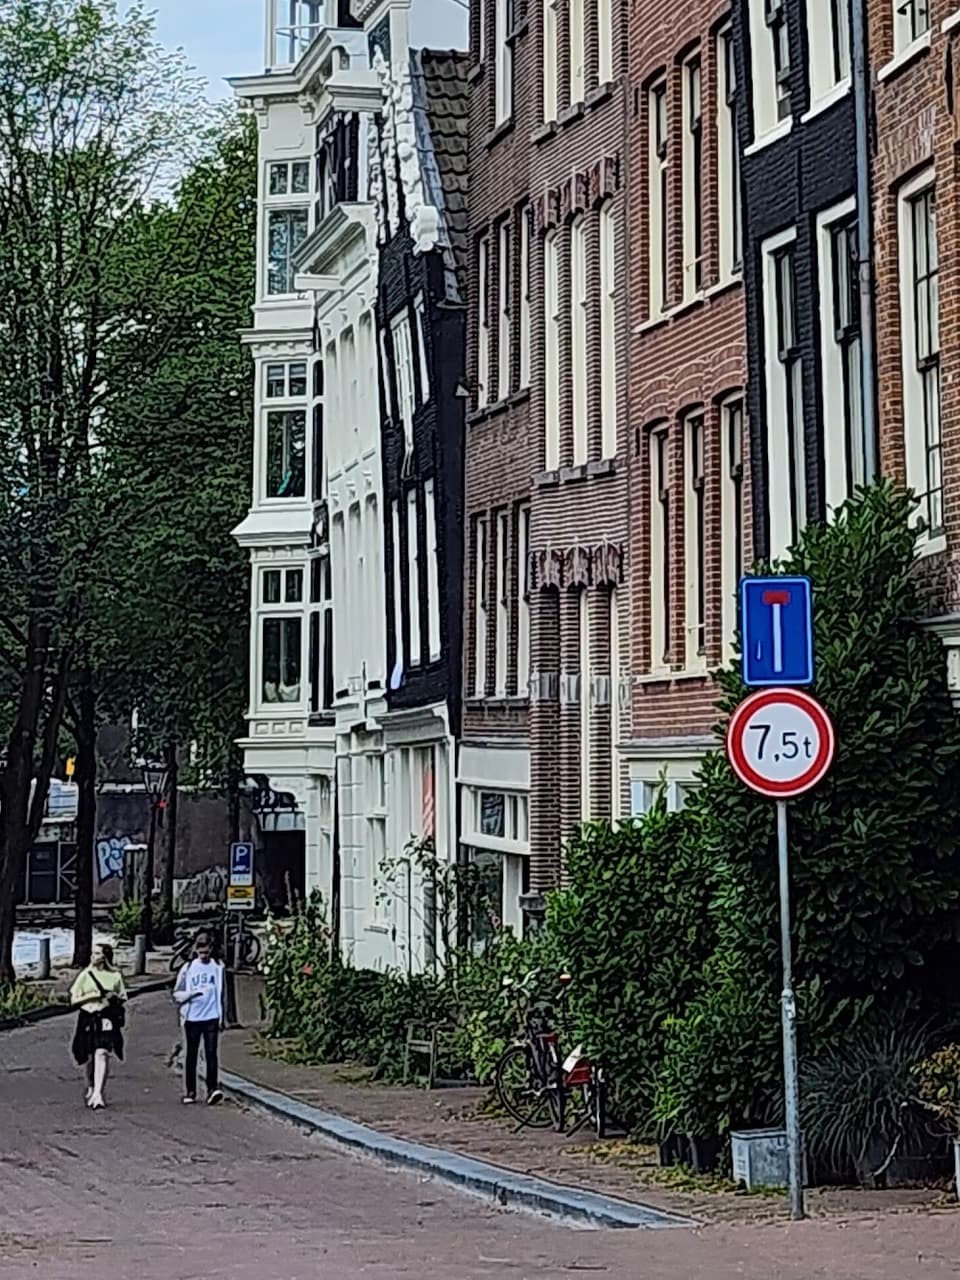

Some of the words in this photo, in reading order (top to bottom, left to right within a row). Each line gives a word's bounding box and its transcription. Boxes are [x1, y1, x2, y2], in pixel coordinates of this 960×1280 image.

[749, 724, 812, 762] 7,5t
[235, 845, 249, 862] P
[191, 972, 216, 986] USA
